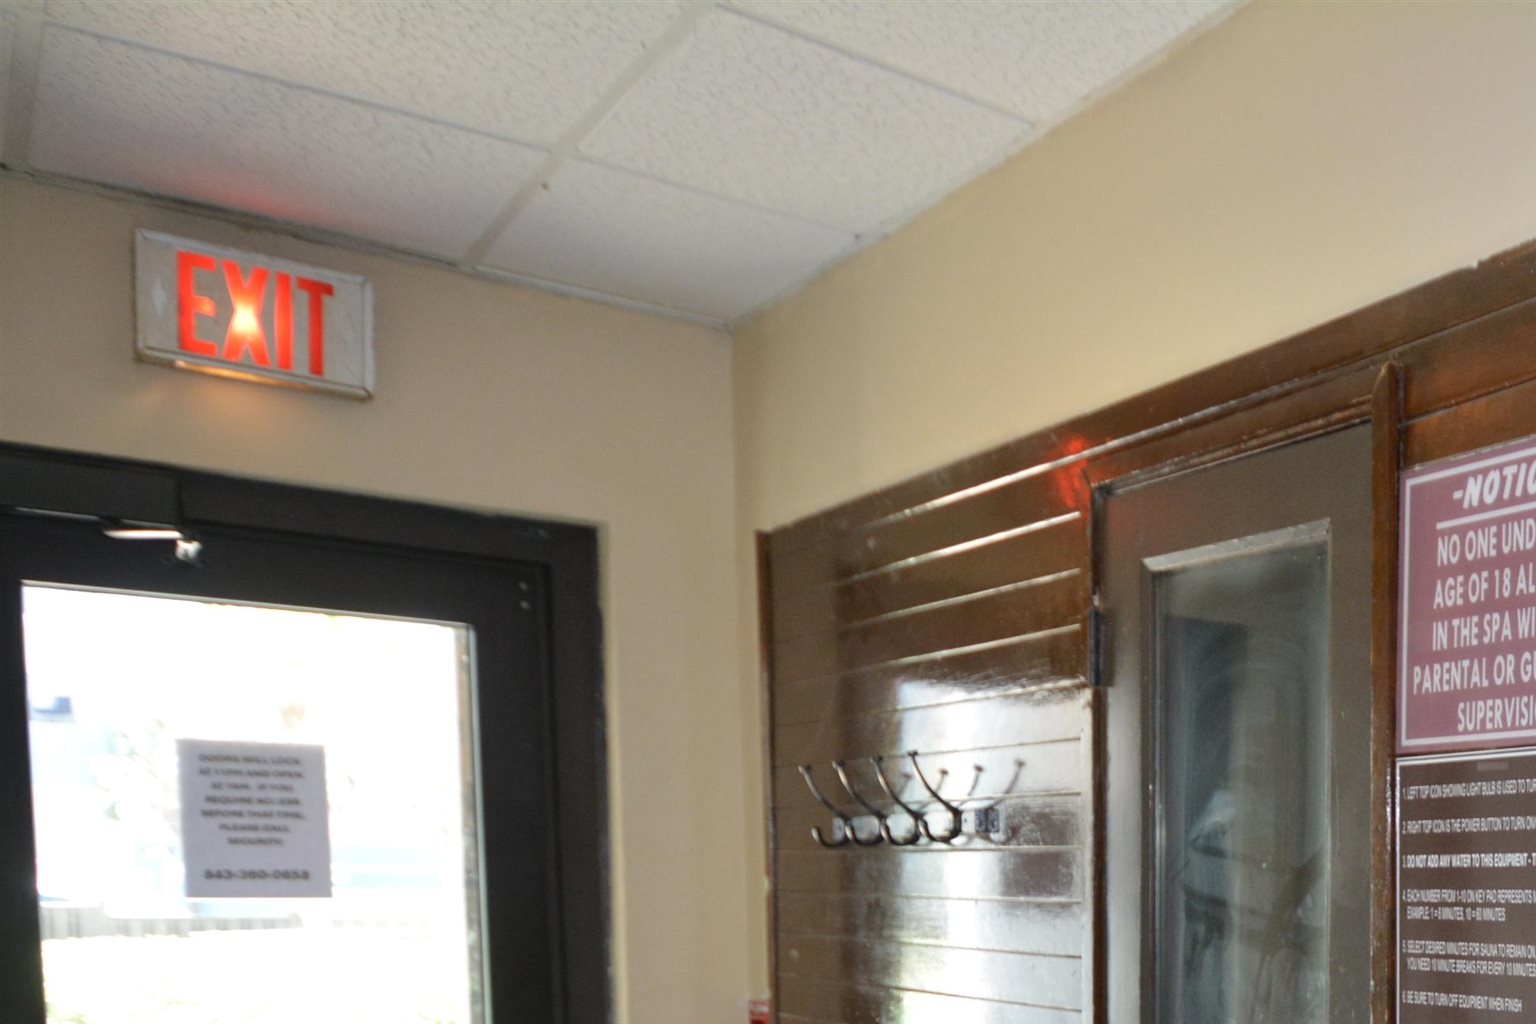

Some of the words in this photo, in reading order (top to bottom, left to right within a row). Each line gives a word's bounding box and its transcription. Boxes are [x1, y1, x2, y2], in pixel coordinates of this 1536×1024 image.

[177, 250, 334, 376] EXIT
[1438, 534, 1460, 566] NO
[1465, 525, 1497, 561] ONE
[1433, 575, 1464, 609] AGE
[1468, 571, 1488, 603] OF
[1495, 567, 1511, 598] 18
[1433, 621, 1448, 650] IN
[1452, 615, 1479, 648] THE
[1483, 611, 1512, 644] SPA
[1413, 657, 1489, 694] PARENTAL
[1493, 654, 1515, 686] OR
[1407, 854, 1414, 867] DO
[1415, 854, 1426, 867] NOT
[1427, 854, 1438, 867] ADD
[1439, 853, 1450, 867] ANY
[1451, 853, 1471, 867] WATER
[1471, 853, 1479, 867] TO
[1480, 853, 1493, 867] THIS
[1494, 852, 1527, 867] EQUIPMENT
